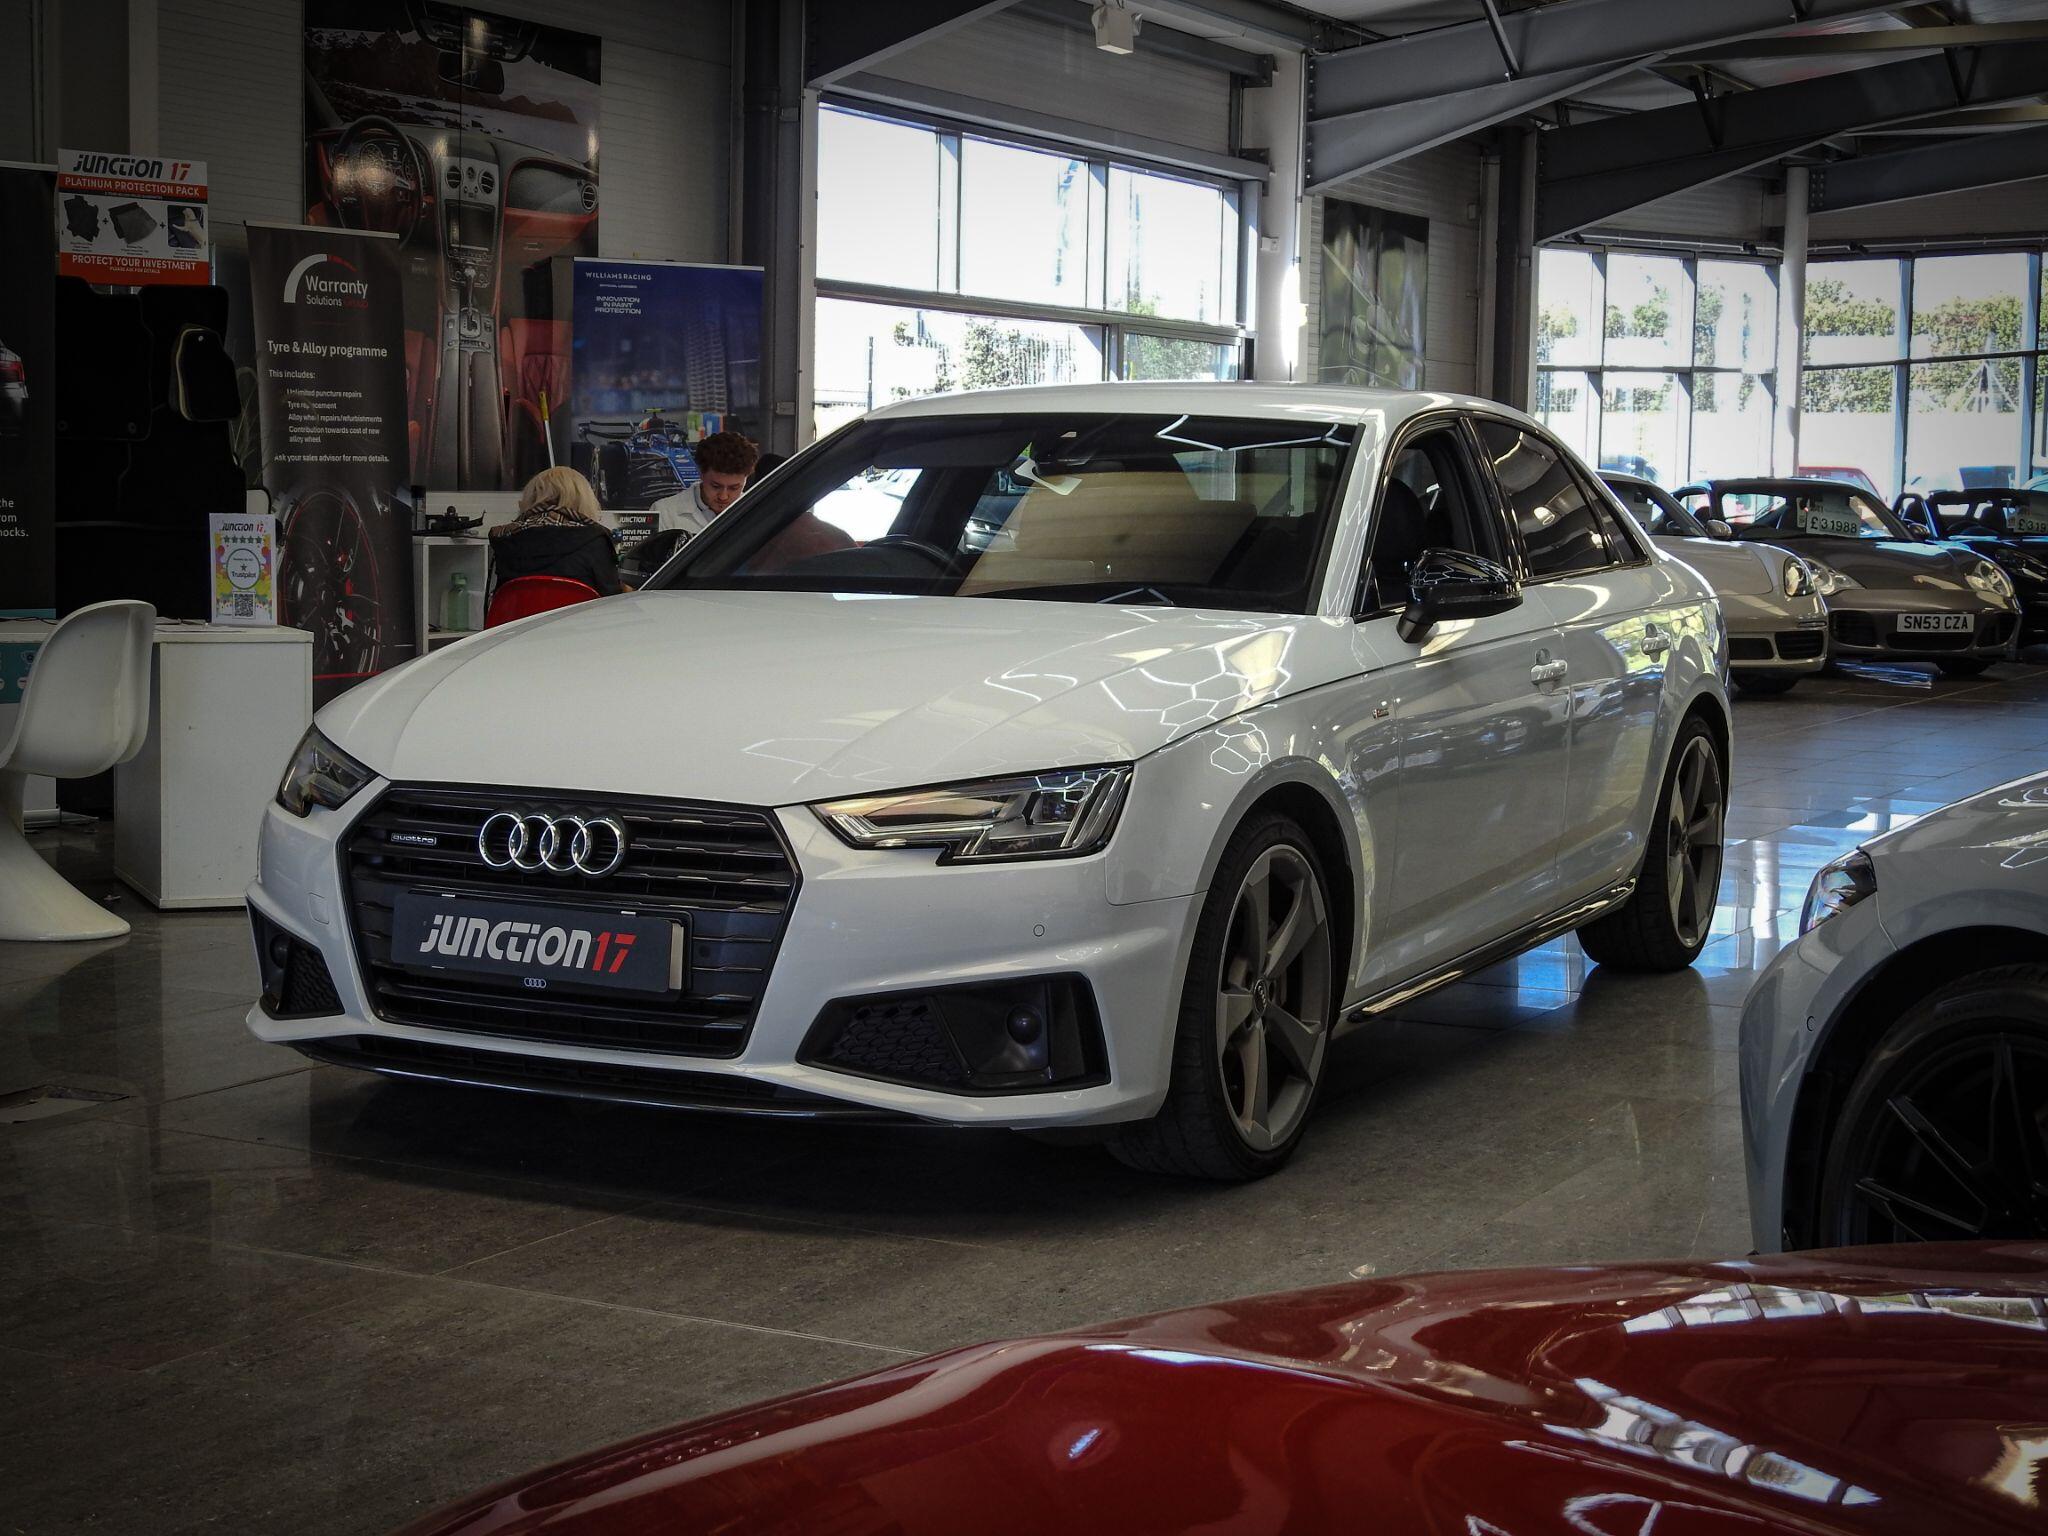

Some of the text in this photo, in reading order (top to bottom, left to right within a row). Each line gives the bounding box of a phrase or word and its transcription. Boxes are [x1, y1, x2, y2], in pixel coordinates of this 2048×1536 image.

[170, 162, 191, 180] 17
[64, 176, 113, 189] PLATINUM
[114, 180, 174, 194] PROTECTION
[175, 186, 201, 196] PACK
[72, 254, 196, 270] PROTECT YOUR INVESTMENT
[306, 275, 368, 299] Warranty
[306, 294, 343, 306] Solutions
[267, 340, 388, 358] Tyre & Alloy programme
[268, 370, 316, 379] This includes:
[286, 388, 315, 396] Unlimited
[342, 391, 362, 399] repairs
[288, 400, 300, 409] Tyre
[288, 413, 303, 422] Alloy
[288, 426, 324, 434] Contribution
[1904, 616, 1968, 629] SN53 CZA
[392, 835, 434, 843] quattro
